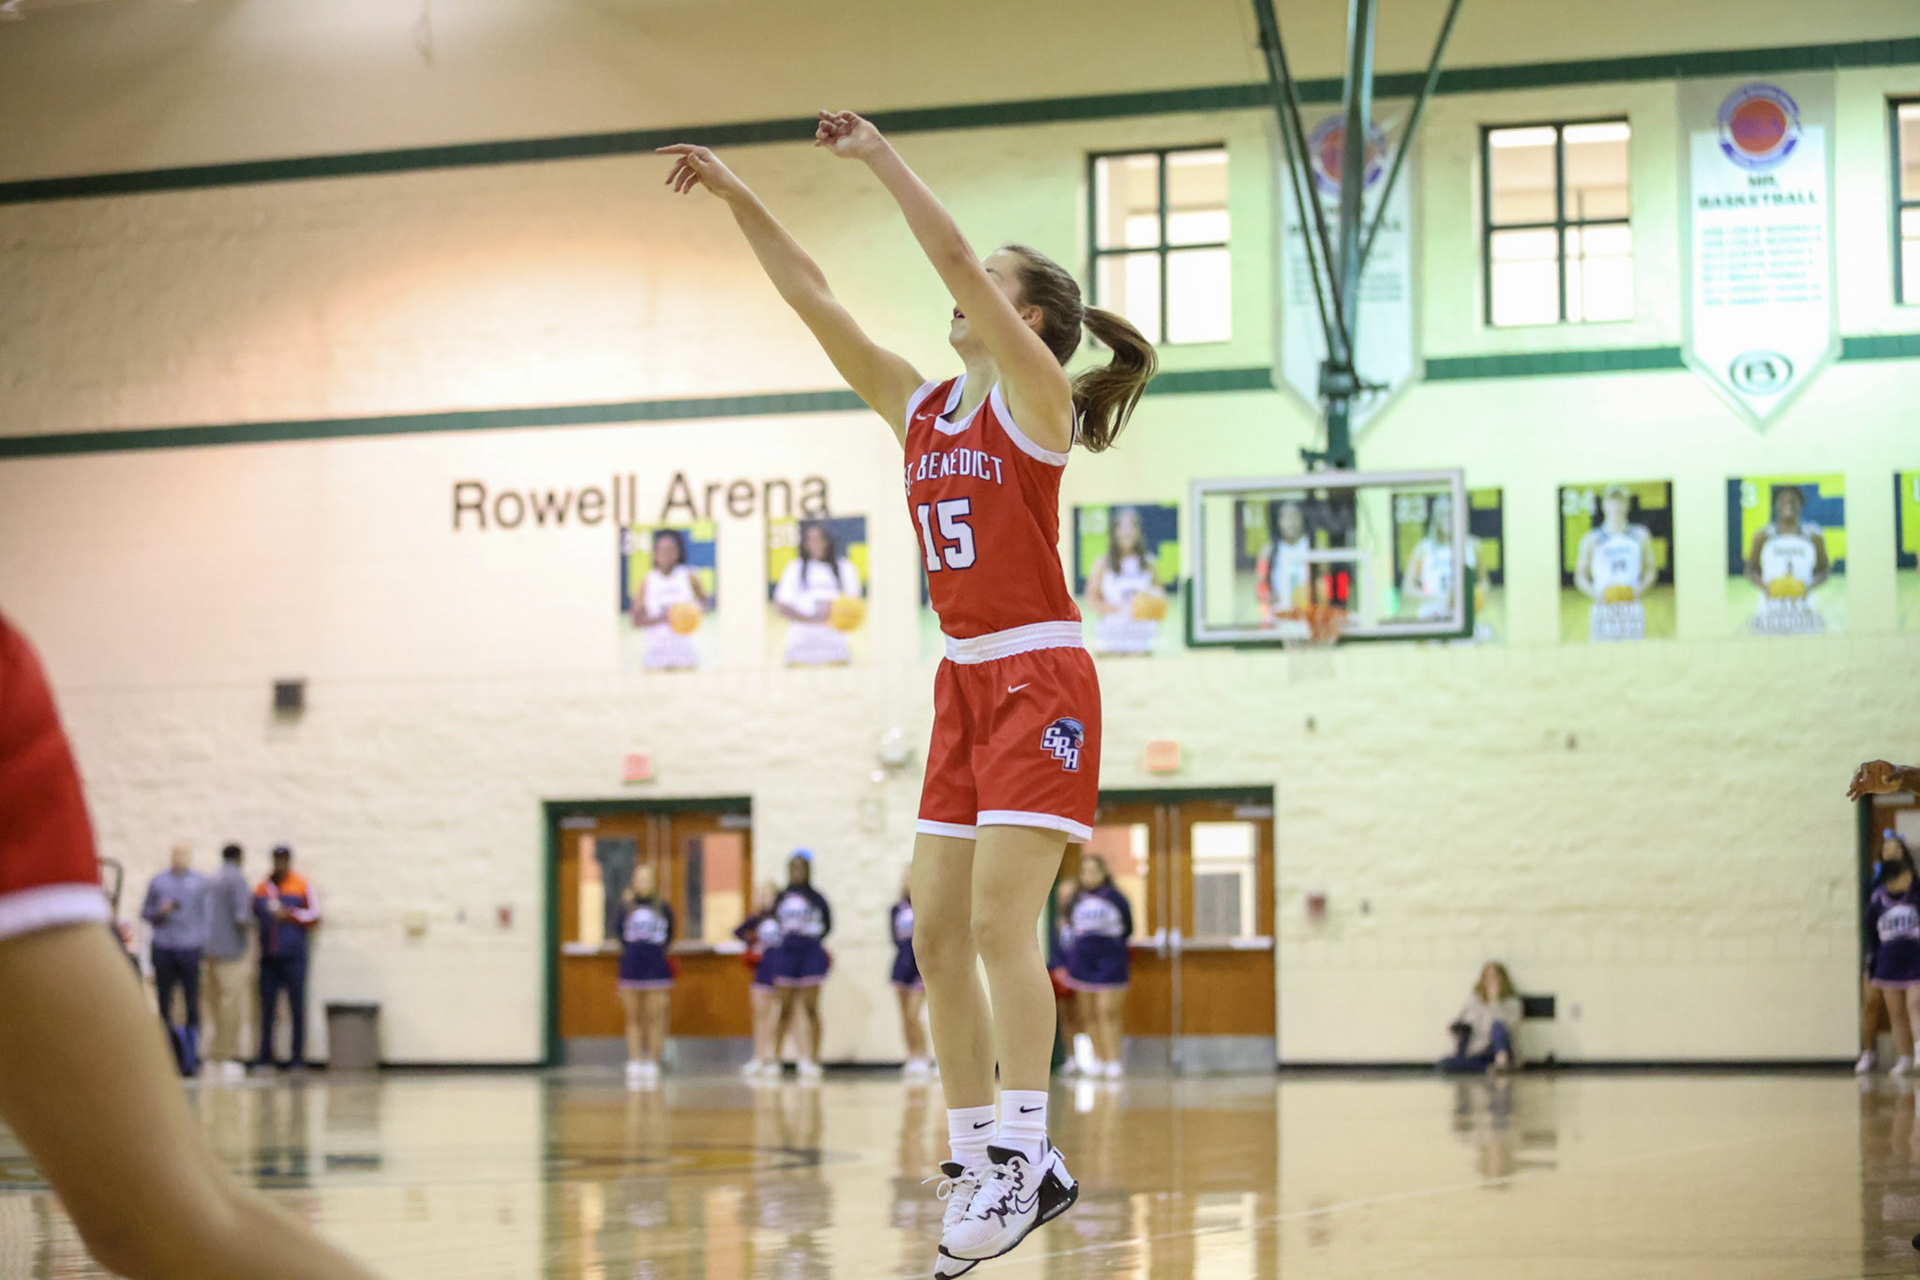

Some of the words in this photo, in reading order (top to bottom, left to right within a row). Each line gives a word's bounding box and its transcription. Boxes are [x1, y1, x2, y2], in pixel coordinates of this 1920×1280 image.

[916, 448, 1003, 485] BENEDICT
[453, 474, 636, 531] Rowell
[661, 471, 831, 525] Arena
[917, 496, 977, 573] 15
[1042, 723, 1079, 770] SBA
